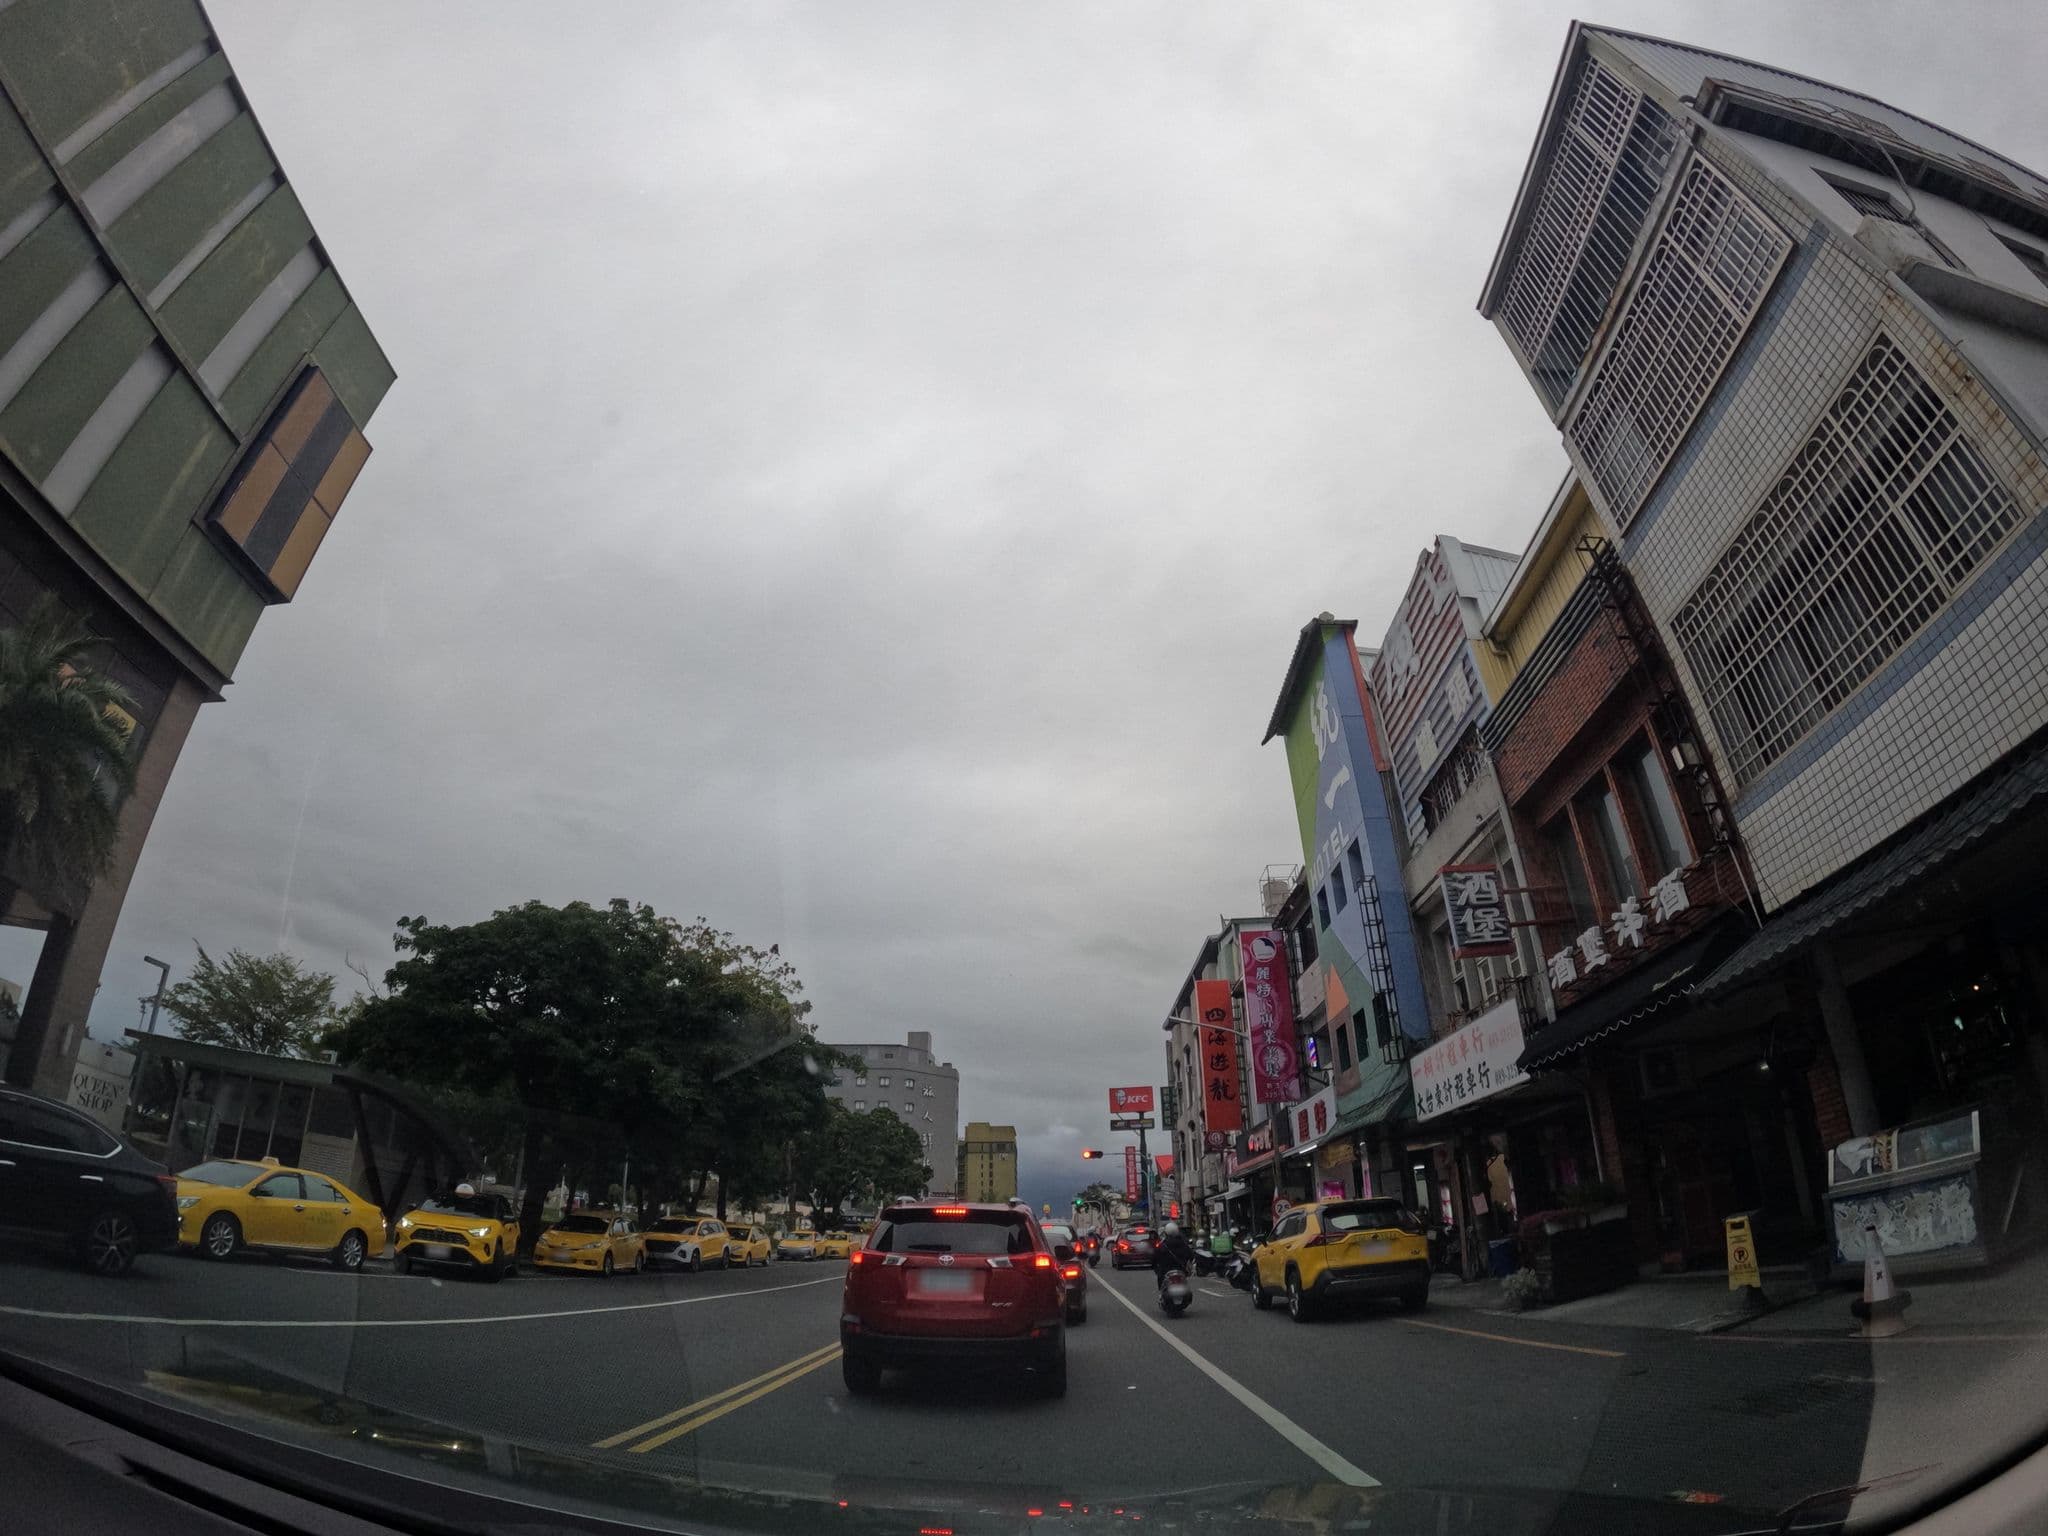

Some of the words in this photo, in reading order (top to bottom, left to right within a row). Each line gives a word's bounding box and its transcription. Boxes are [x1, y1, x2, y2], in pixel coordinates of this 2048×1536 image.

[1451, 872, 1510, 944] 酒堡
[1206, 1008, 1235, 1101] 四海遊龍
[77, 1092, 113, 1112] SHOP
[1127, 1094, 1149, 1104] KFC
